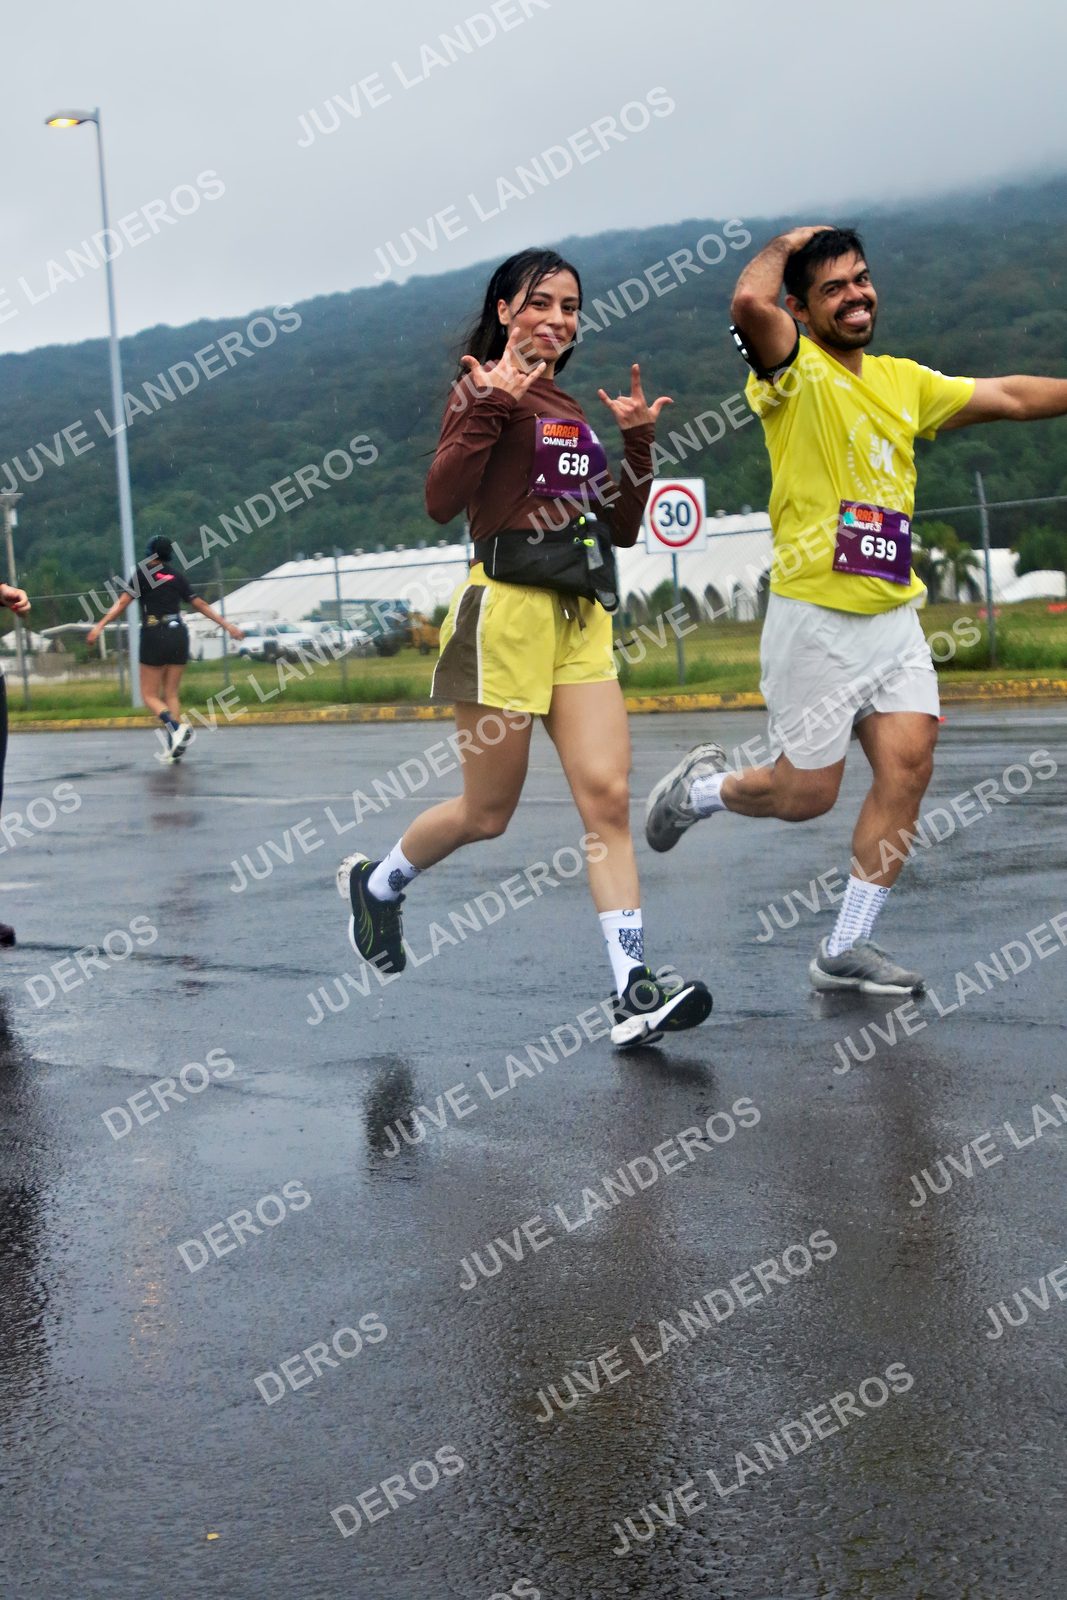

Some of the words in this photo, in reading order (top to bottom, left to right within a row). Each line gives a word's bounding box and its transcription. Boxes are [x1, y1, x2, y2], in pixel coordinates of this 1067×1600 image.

[558, 452, 590, 476] 638
[658, 501, 691, 527] 30
[860, 534, 897, 561] 639
